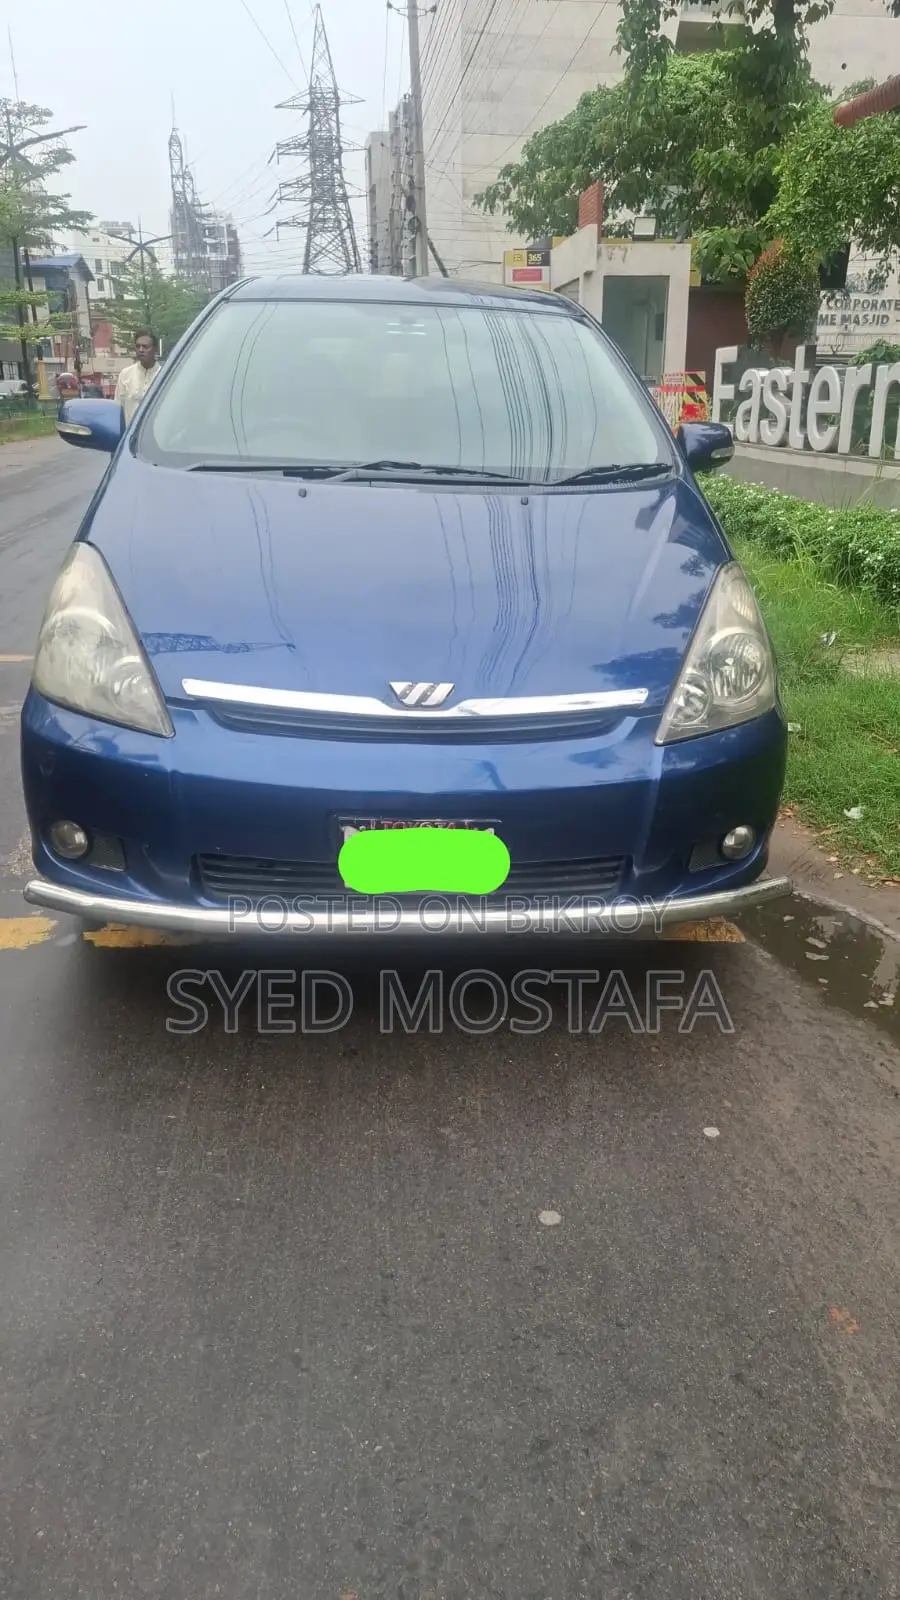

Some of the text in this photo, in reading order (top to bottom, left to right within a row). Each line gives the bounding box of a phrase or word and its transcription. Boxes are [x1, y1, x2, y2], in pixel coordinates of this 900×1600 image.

[826, 299, 900, 312] CORPORATE
[841, 314, 890, 326] MASJID
[712, 345, 900, 459] Eastern
